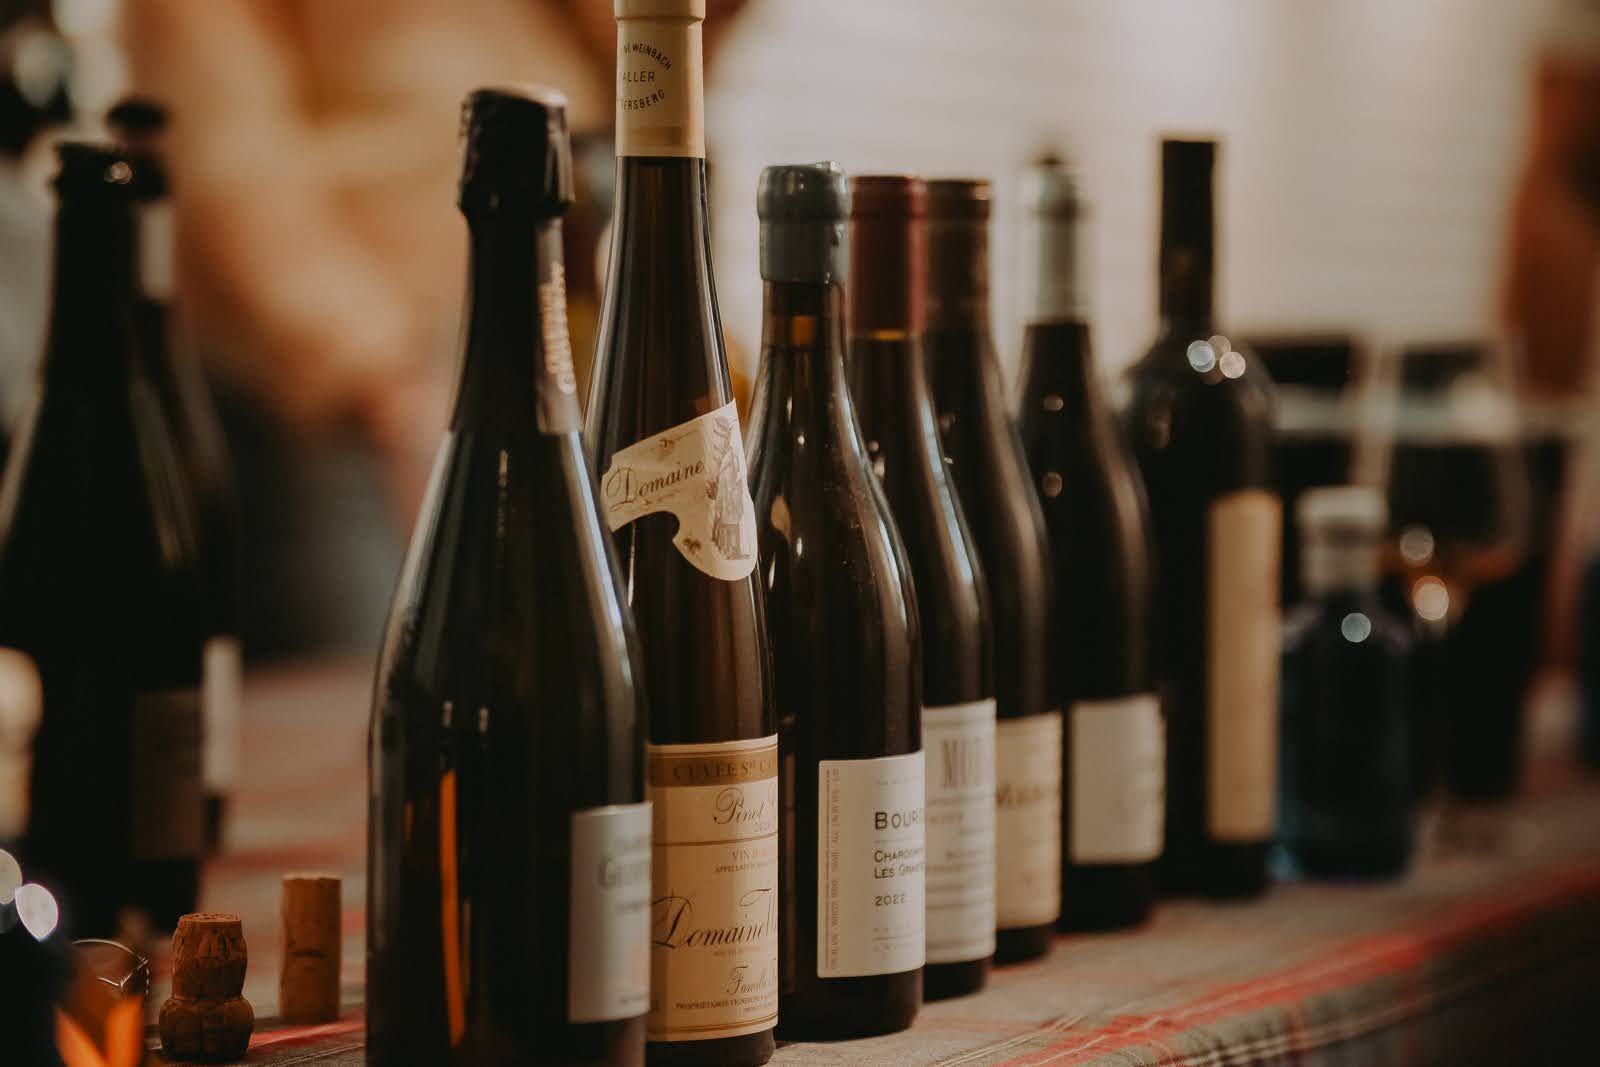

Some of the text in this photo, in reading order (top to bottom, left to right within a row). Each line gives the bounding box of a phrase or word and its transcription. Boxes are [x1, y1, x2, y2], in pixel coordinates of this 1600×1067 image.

[632, 43, 672, 71] WEINBACH
[605, 460, 705, 512] Domaine
[712, 787, 765, 825] Pinot
[874, 866, 895, 880] LES
[874, 894, 906, 907] 2022
[651, 888, 766, 950] Domaine
